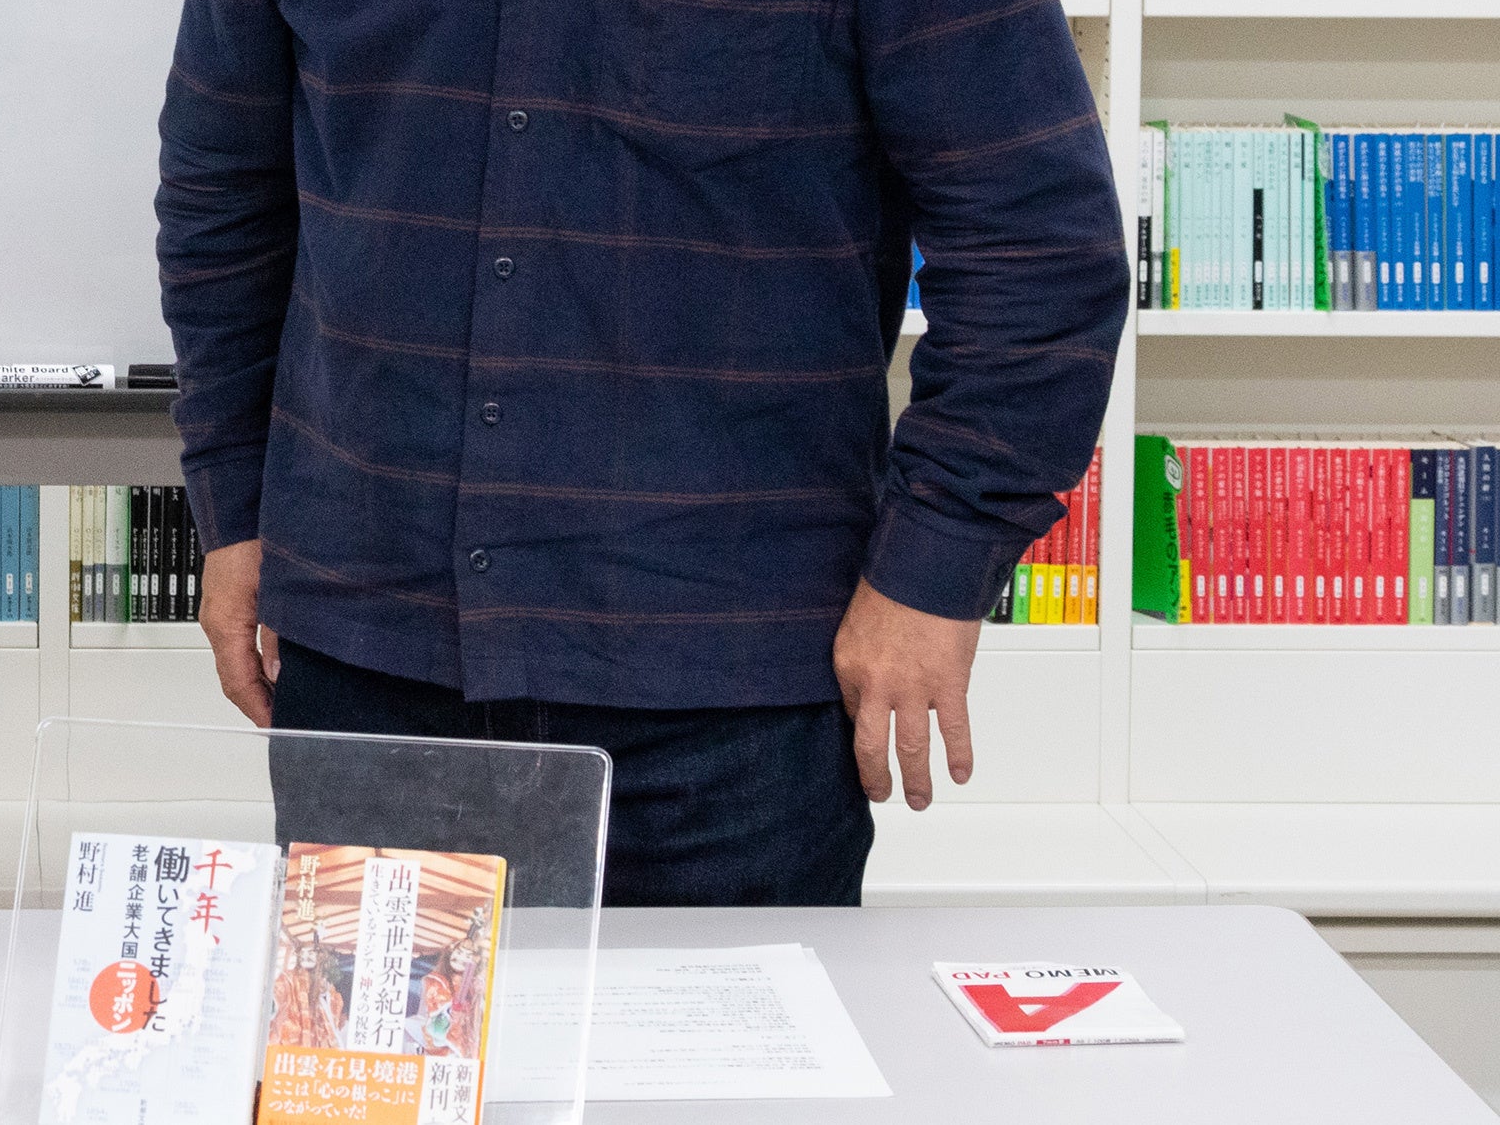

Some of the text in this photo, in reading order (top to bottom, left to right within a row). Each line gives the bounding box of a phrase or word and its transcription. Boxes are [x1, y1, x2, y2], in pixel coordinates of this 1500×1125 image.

[31, 366, 69, 374] Board
[296, 854, 321, 921] 野村進
[141, 845, 191, 1033] 働いてきました
[372, 864, 414, 1049] 出雲世界紀行
[952, 968, 1121, 980] MEMO PAD
[271, 1079, 415, 1105] ここは「心の根っこ」に
